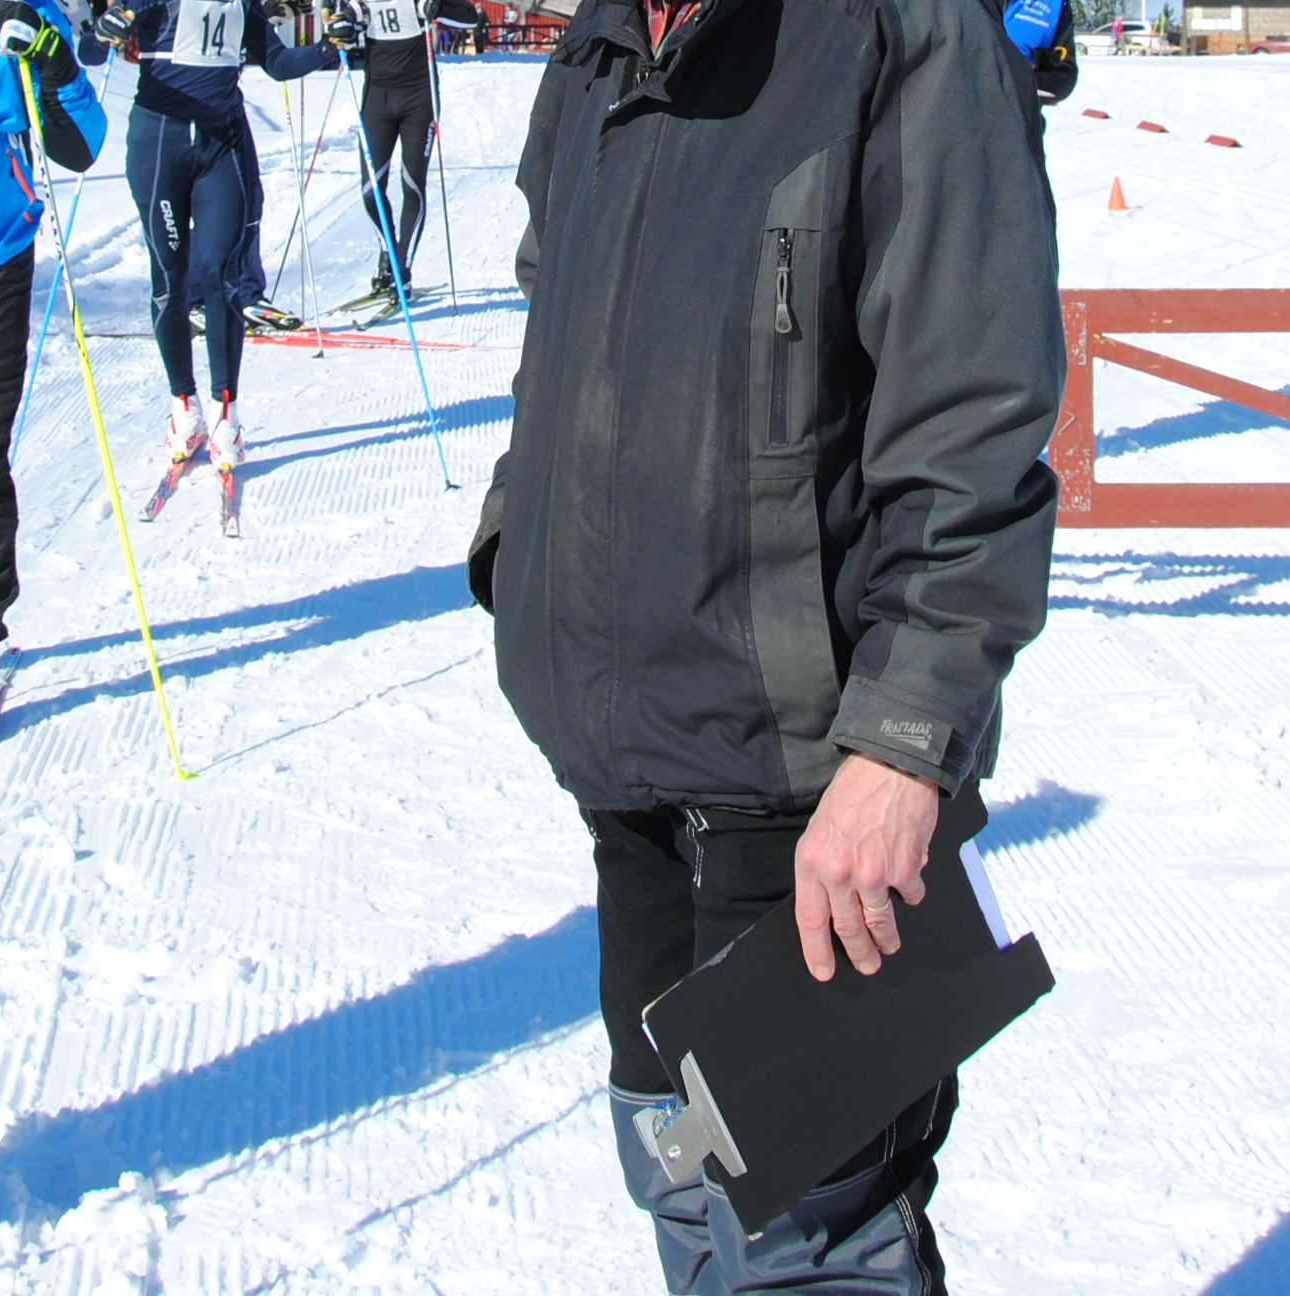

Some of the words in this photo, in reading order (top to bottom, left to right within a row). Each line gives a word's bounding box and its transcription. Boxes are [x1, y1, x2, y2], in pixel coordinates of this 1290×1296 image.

[202, 12, 226, 56] 14
[378, 8, 400, 33] 18
[423, 128, 434, 157] CRAFT
[160, 200, 179, 240] CRAFT
